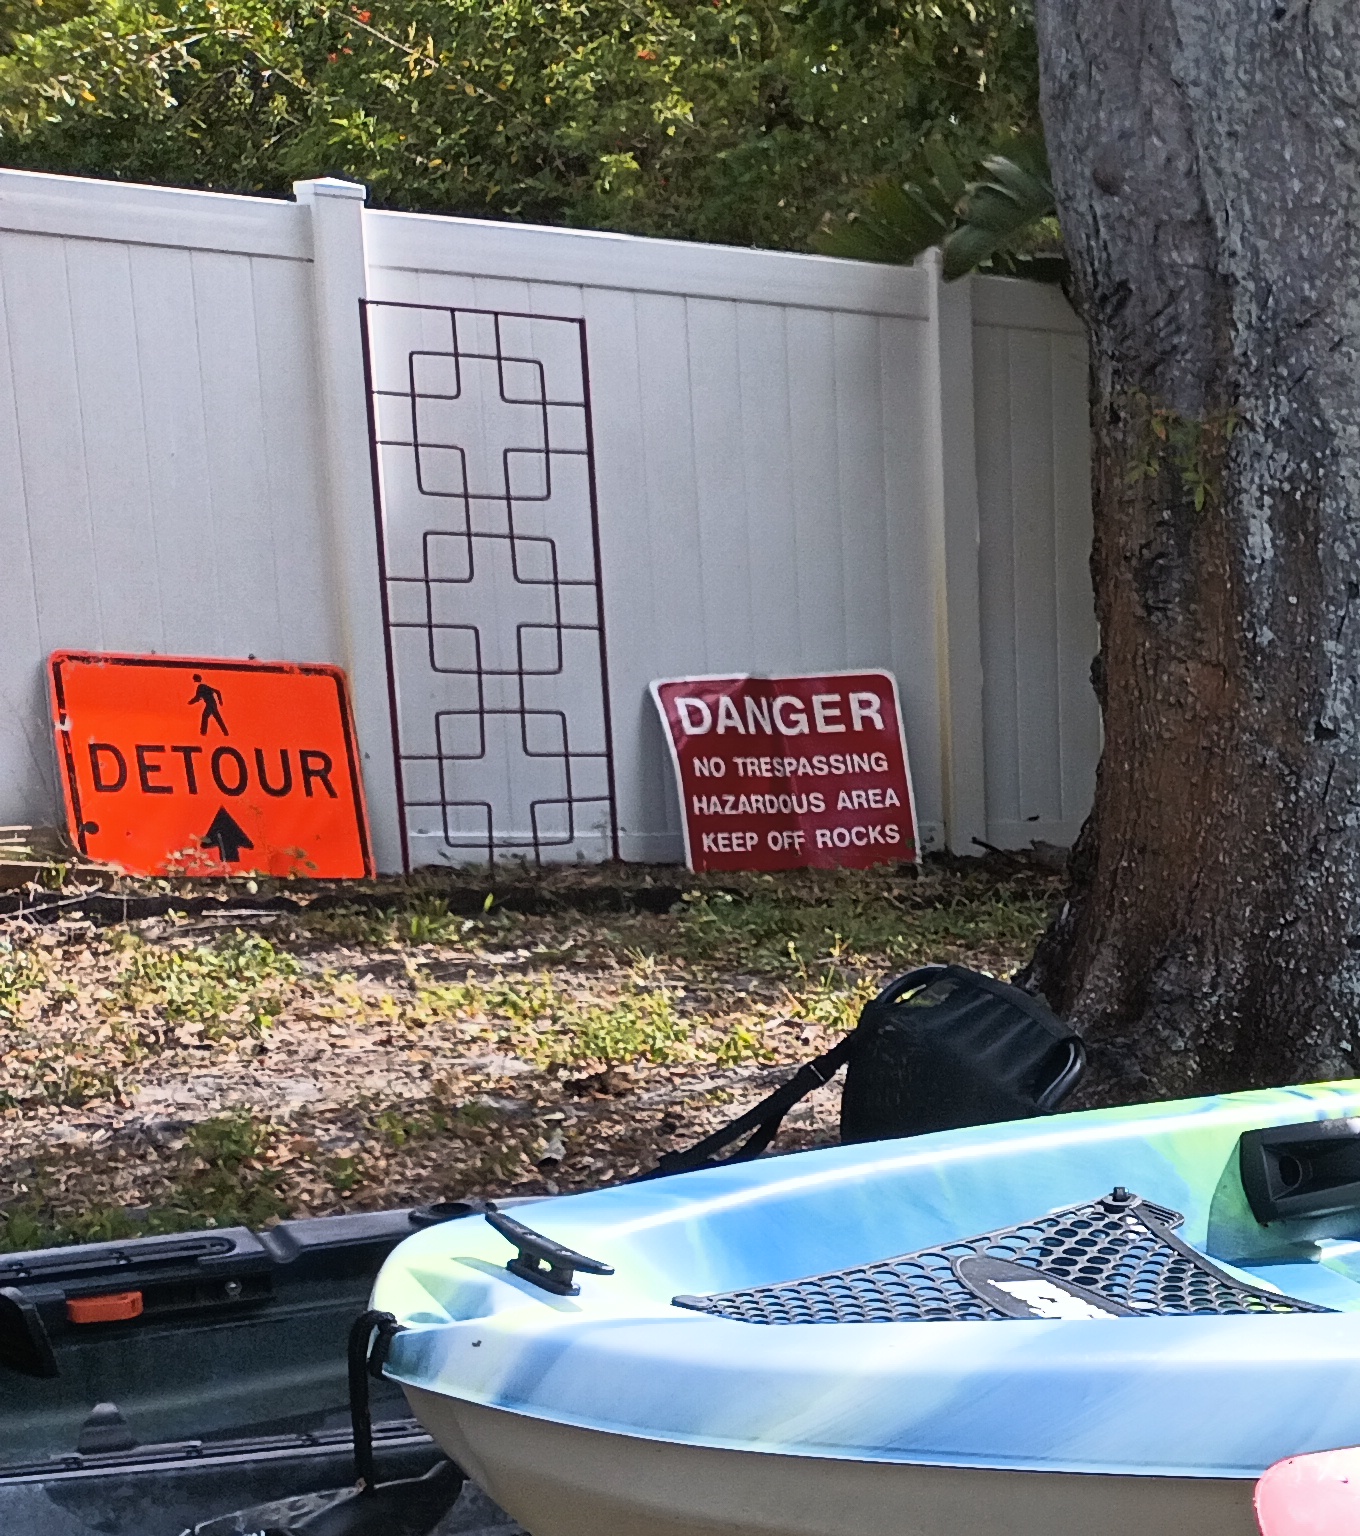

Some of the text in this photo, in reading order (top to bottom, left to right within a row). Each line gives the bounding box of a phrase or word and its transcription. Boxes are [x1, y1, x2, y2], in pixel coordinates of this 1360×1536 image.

[673, 691, 886, 736] DANGER
[88, 742, 339, 799] DETOUR
[692, 751, 889, 778] NO TRESPASSING
[692, 788, 901, 815] HAZARDOUS AREA
[702, 824, 901, 853] KEEP OFF ROCKS
